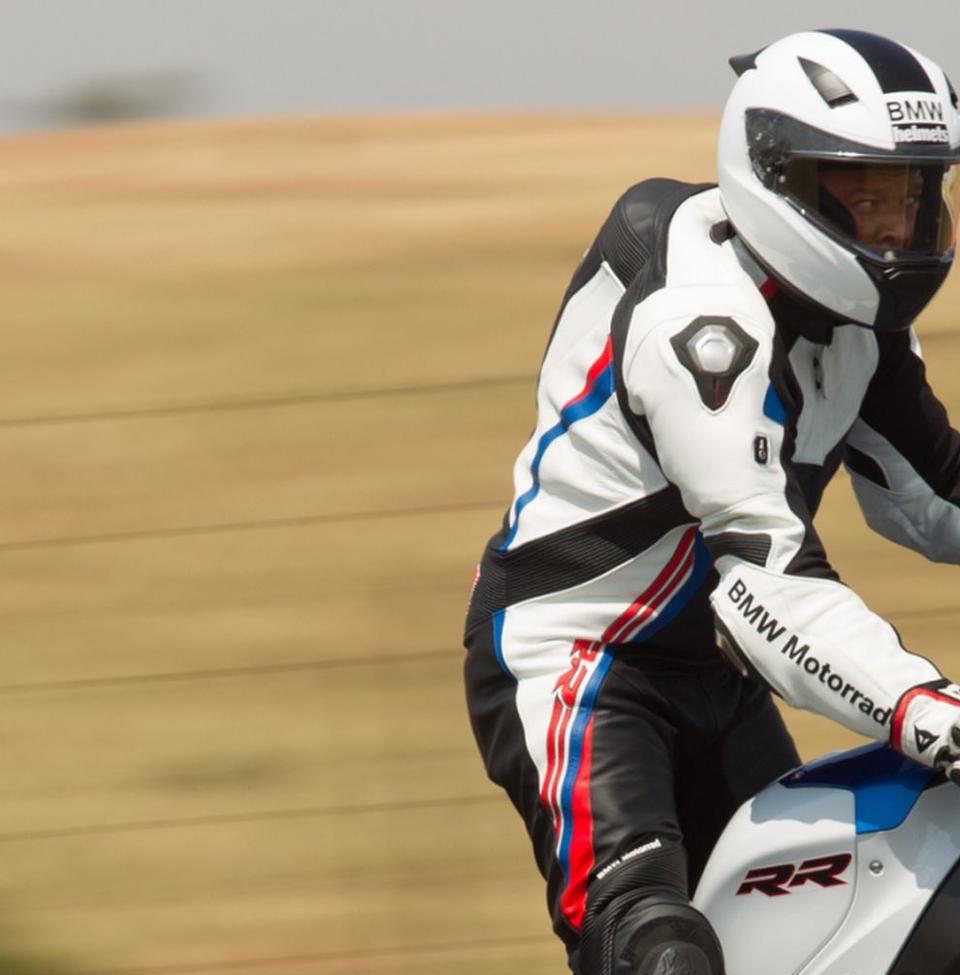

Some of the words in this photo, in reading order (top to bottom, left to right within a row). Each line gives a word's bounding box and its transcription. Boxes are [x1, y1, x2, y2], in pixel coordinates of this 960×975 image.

[886, 100, 943, 121] BMW
[728, 579, 787, 643] BMW
[781, 634, 893, 727] Motorrad
[735, 852, 853, 897] RR
